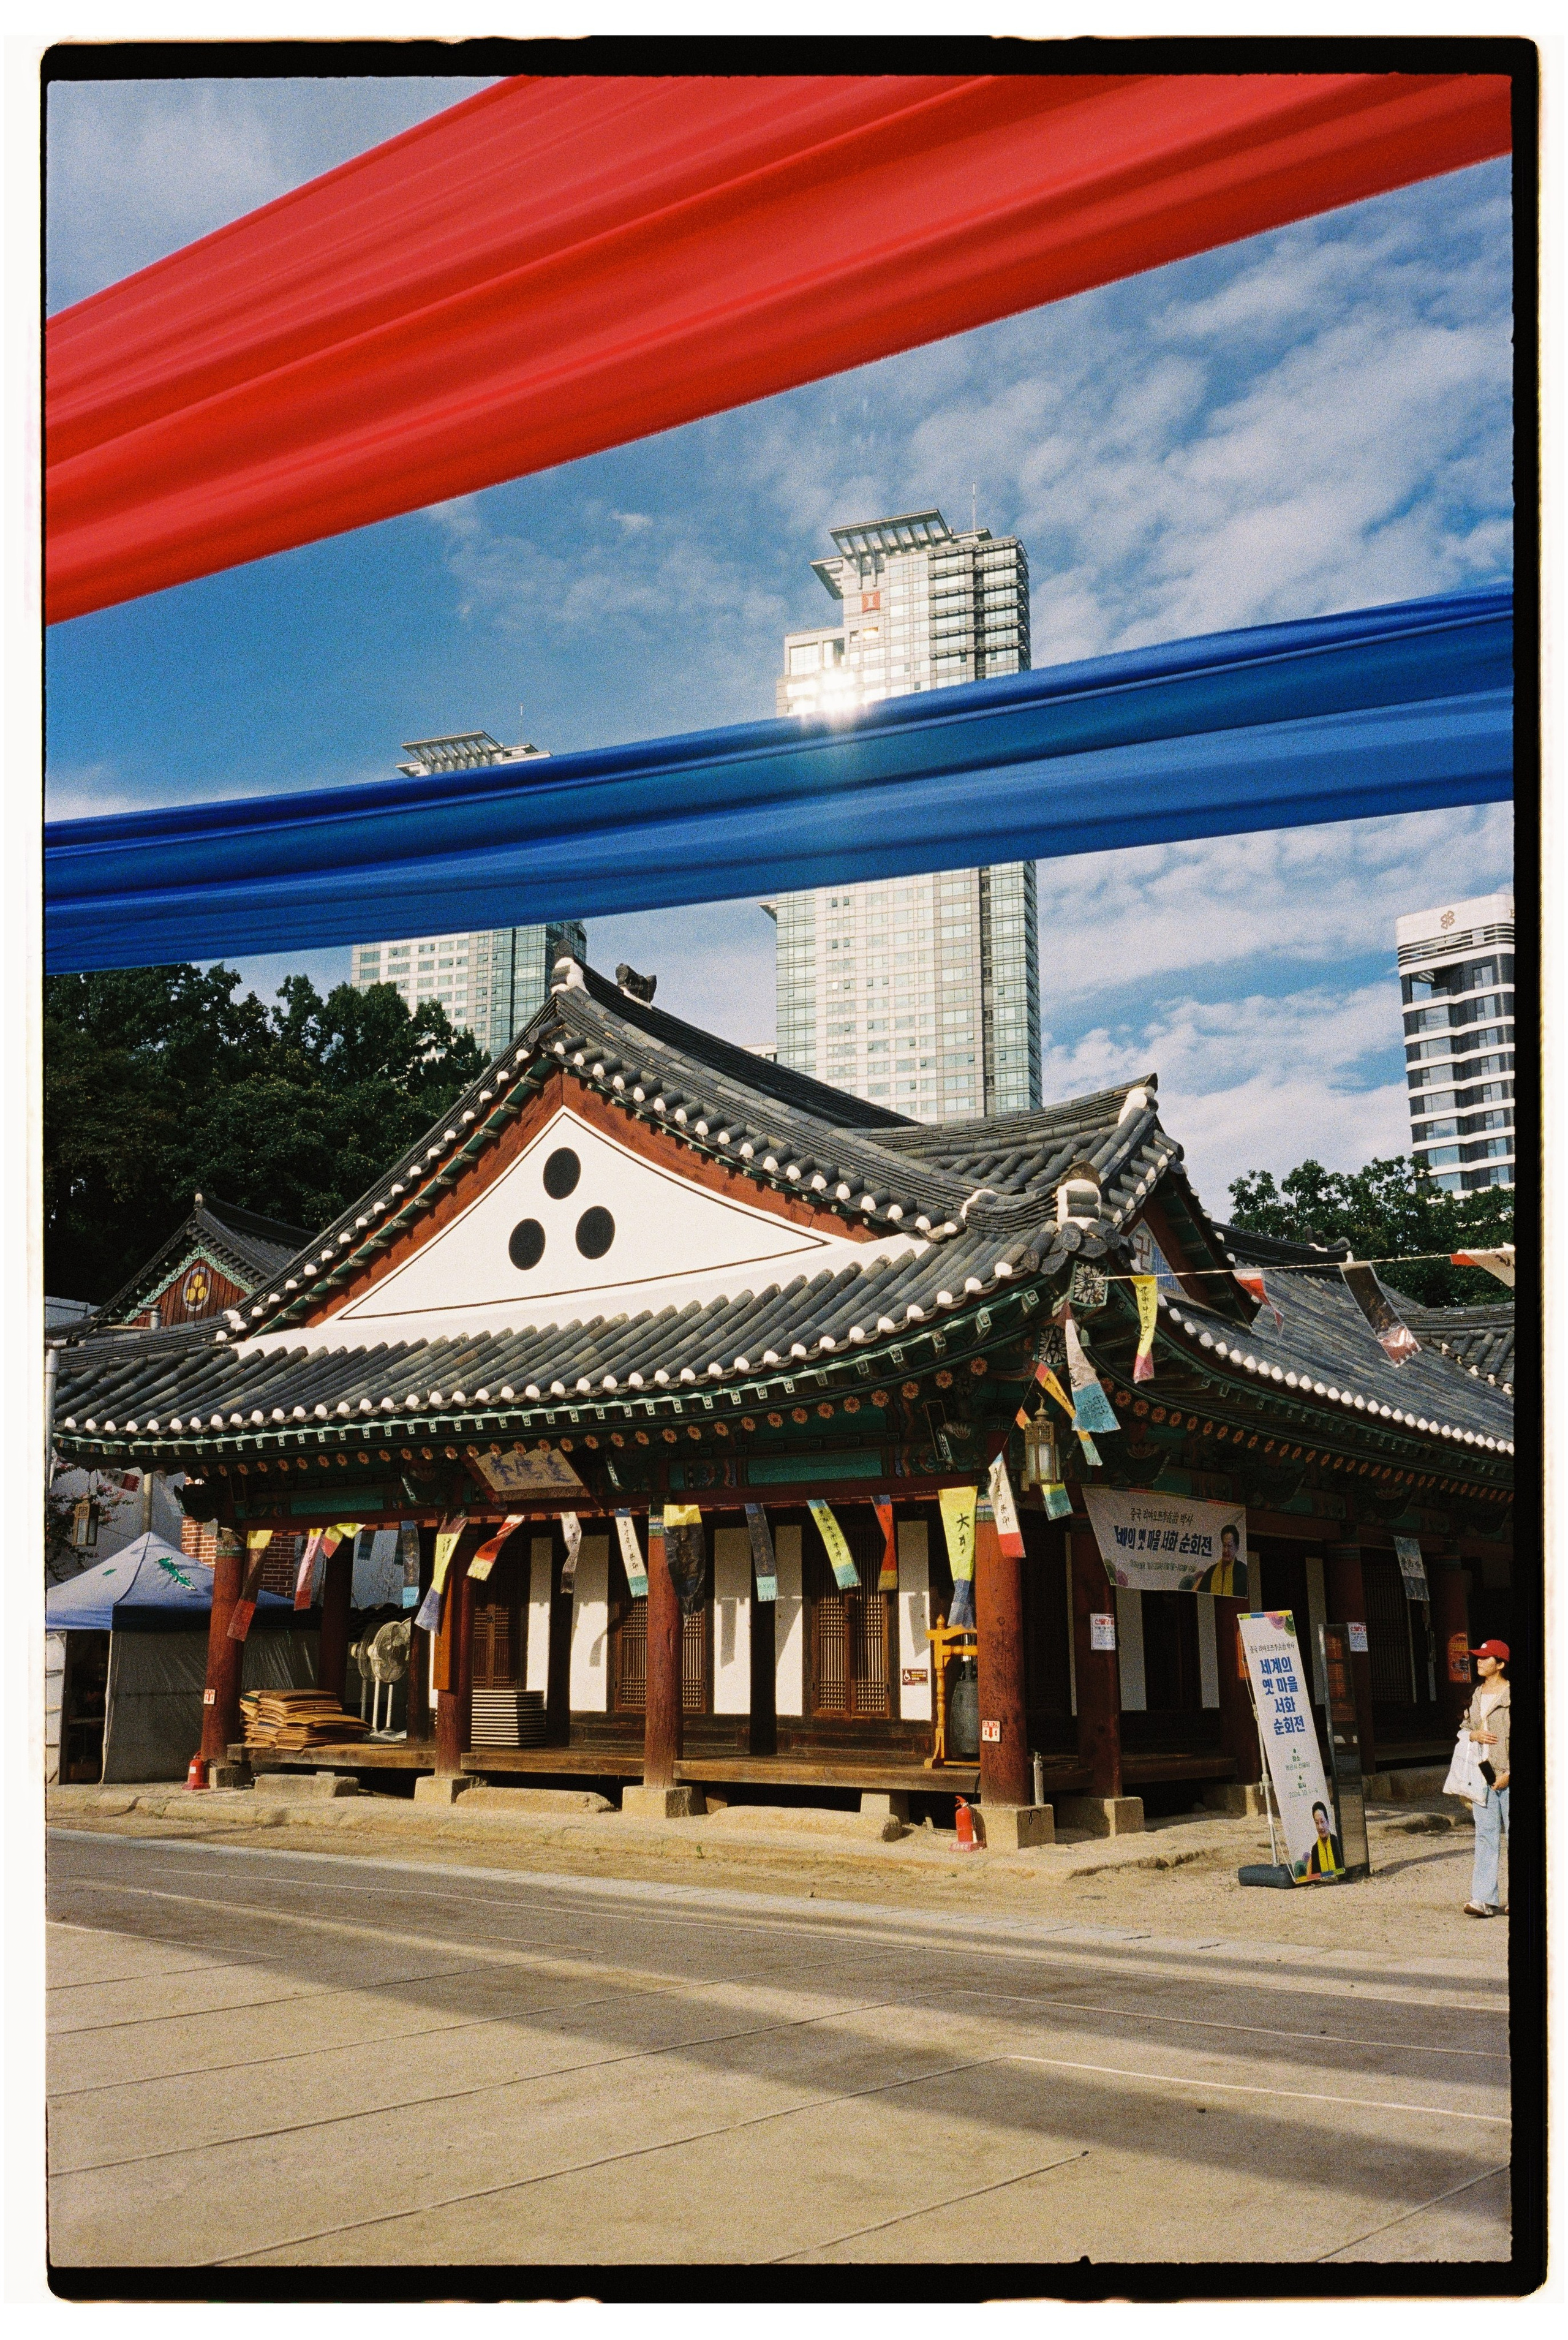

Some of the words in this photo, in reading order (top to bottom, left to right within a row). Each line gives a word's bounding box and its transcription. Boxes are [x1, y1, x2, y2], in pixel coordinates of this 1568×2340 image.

[1130, 1508, 1142, 1522] 중국
[1180, 1512, 1193, 1527] 박사
[1137, 1529, 1147, 1550] 옛
[1147, 1530, 1161, 1551] 마을
[1161, 1530, 1178, 1552] 서화
[1179, 1533, 1212, 1557] 순회전
[1250, 1645, 1258, 1654] 중국
[1259, 1656, 1293, 1675] 세계의
[1262, 1678, 1275, 1695] 옛
[1276, 1675, 1298, 1693] 마을
[1274, 1696, 1295, 1713] 서화
[1273, 1715, 1305, 1735] 순회전
